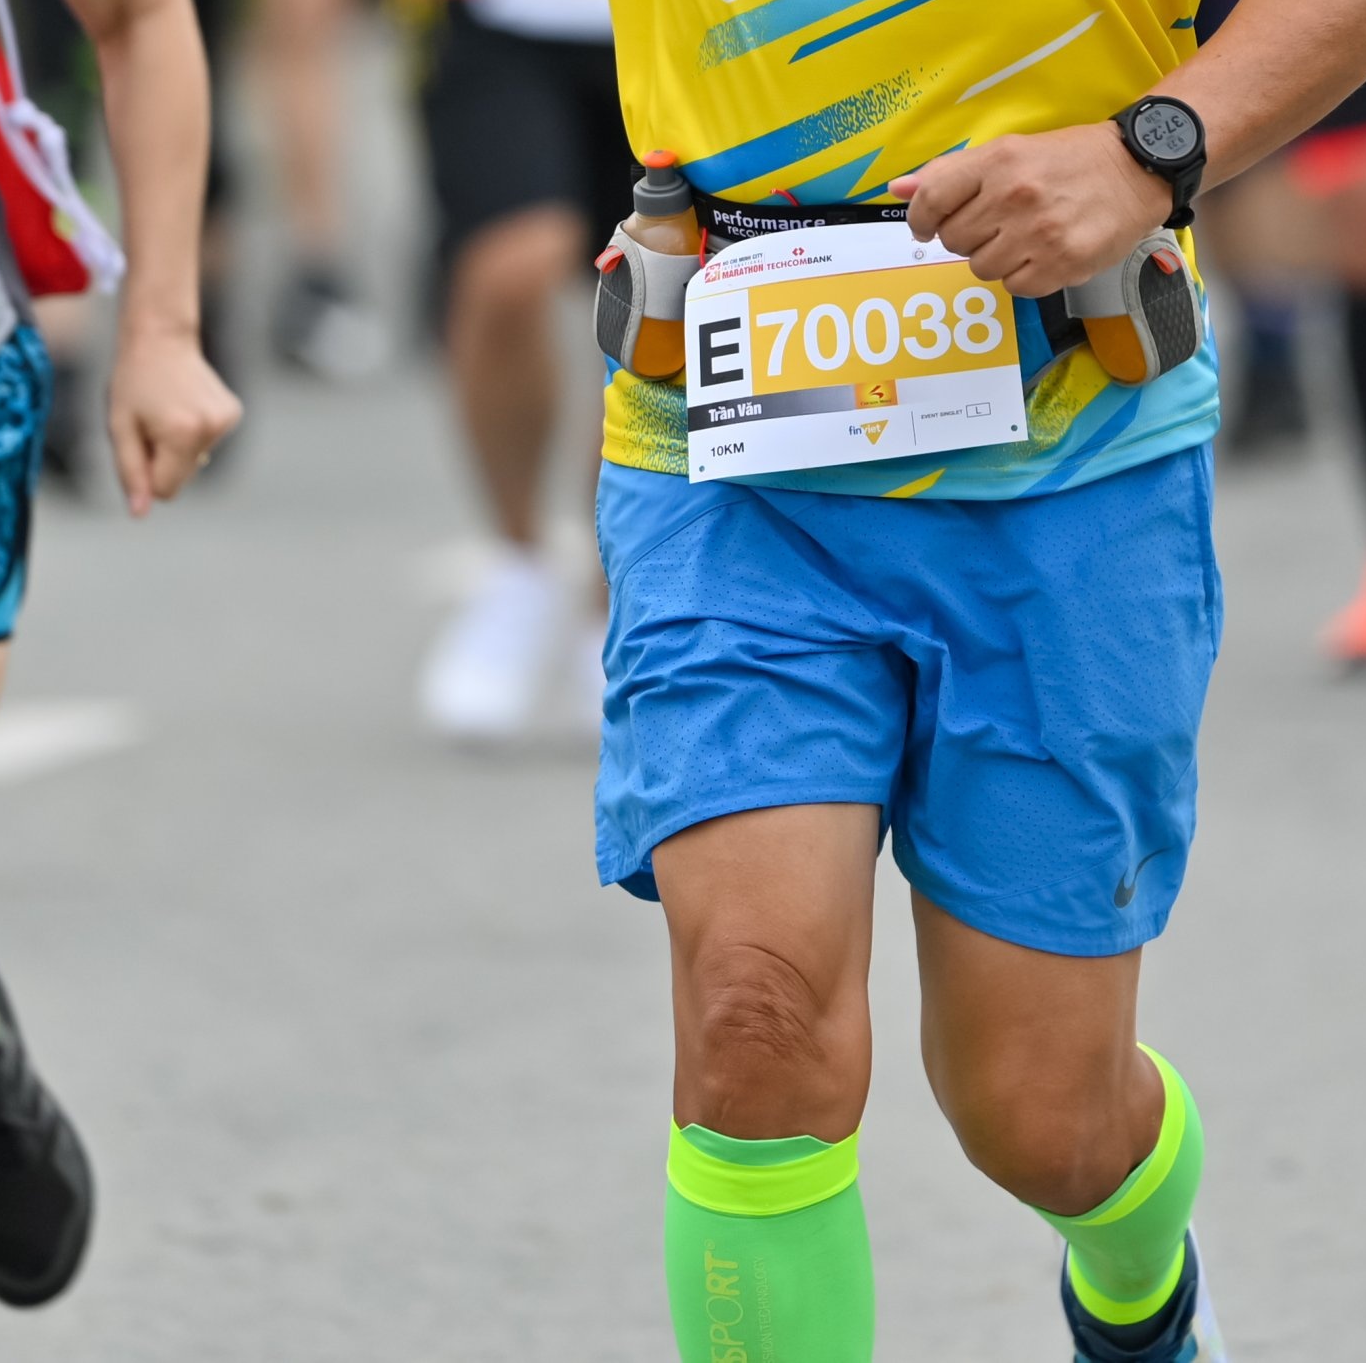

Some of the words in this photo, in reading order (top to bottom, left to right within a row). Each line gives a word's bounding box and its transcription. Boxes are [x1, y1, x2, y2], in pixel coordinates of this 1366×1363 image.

[1142, 115, 1184, 147] 37:23
[713, 209, 826, 231] performance
[752, 252, 764, 260] CITY
[767, 255, 833, 271] TECHCOMBANK
[722, 264, 764, 280] MARATHON
[698, 317, 744, 388] E
[755, 286, 1004, 378] 70038
[708, 406, 736, 423] Trần
[737, 401, 762, 418] Văn
[921, 411, 939, 420] EVENT
[940, 409, 963, 417] SINGLET
[710, 442, 745, 457] 10KM
